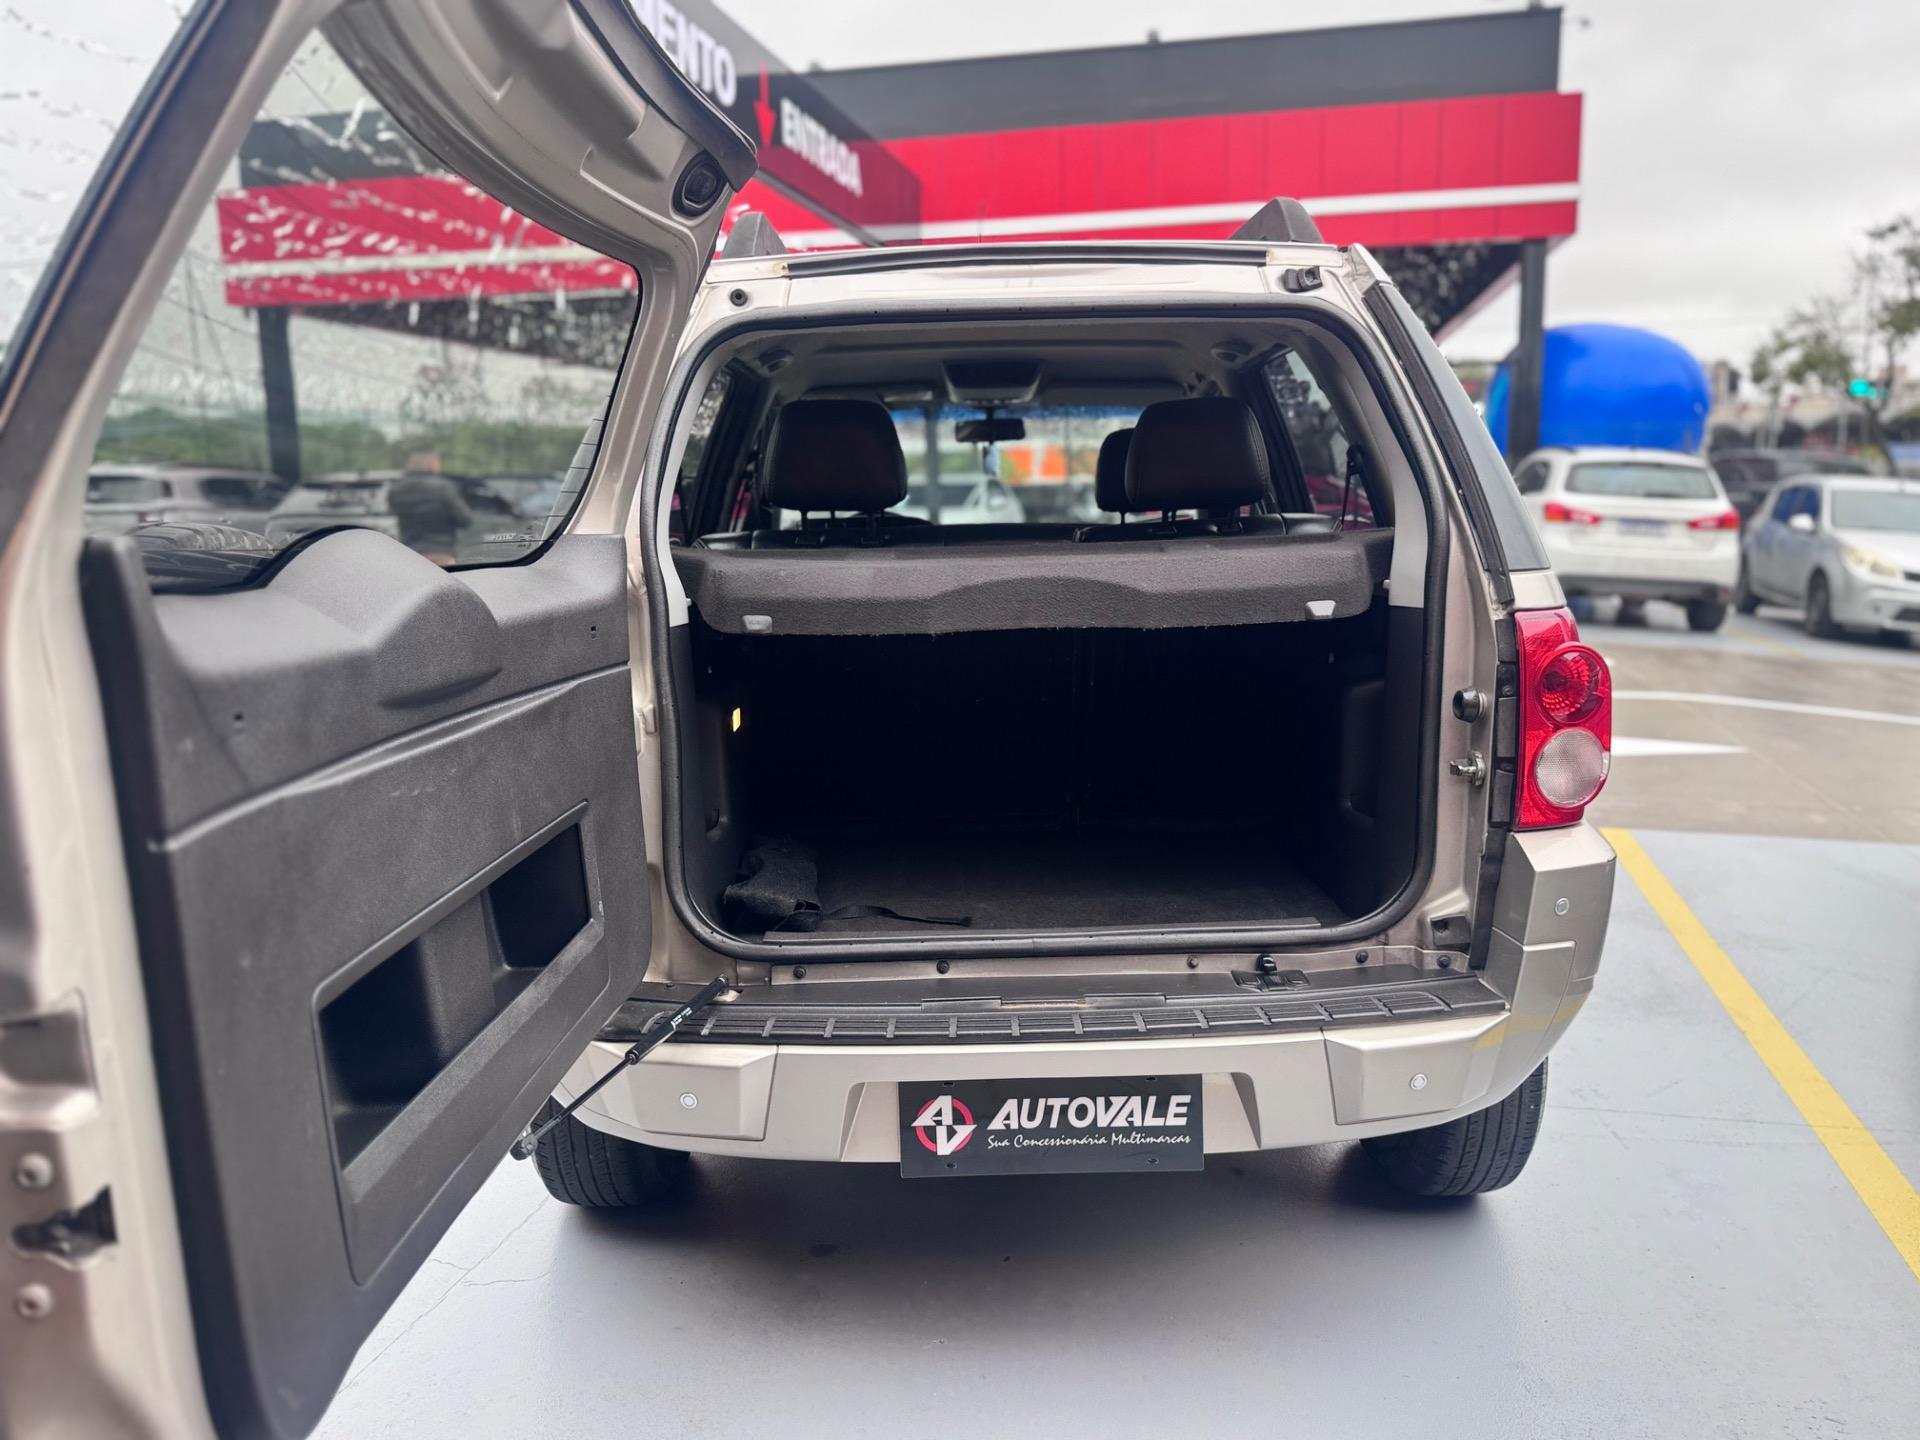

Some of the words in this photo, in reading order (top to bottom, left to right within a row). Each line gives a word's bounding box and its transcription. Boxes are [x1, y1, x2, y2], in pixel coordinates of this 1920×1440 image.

[781, 97, 863, 197] ENTRADA
[987, 1095, 1191, 1130] AUTOVALE
[987, 1135, 1010, 1149] Sua
[1013, 1134, 1108, 1148] Concessionária
[1111, 1131, 1191, 1145] Multimarcas
